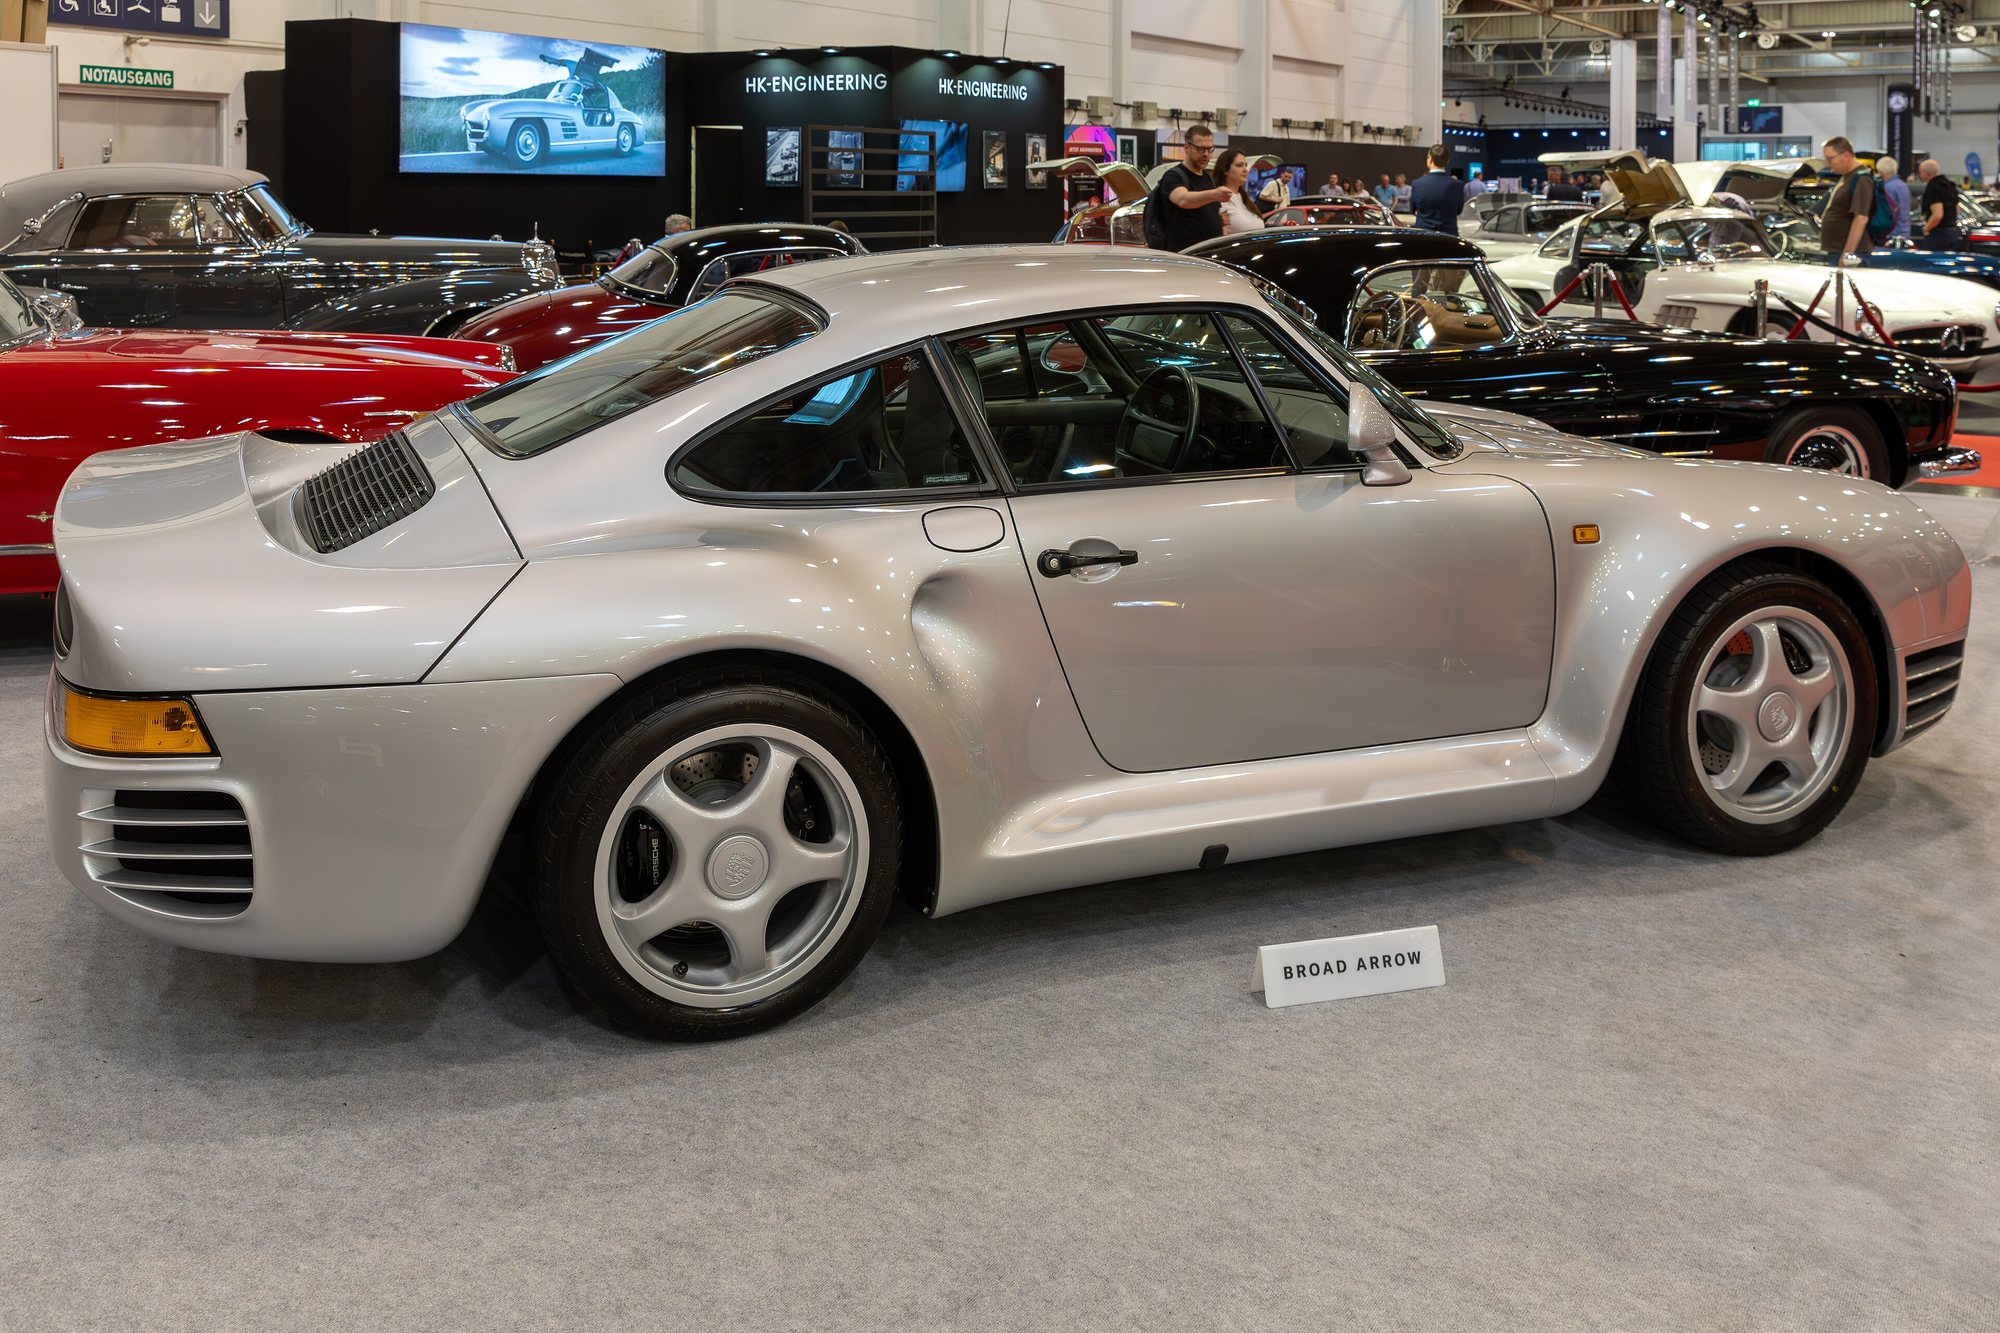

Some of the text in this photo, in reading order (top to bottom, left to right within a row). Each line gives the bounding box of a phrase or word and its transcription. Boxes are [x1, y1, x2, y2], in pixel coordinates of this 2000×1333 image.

[82, 67, 172, 86] NOTAUSGANG
[745, 73, 888, 93] HK-ENGINEERING
[938, 78, 1028, 101] HK-ENGINEERING
[651, 838, 660, 885] PORSCHE
[1283, 951, 1422, 980] BROAD ARROW
